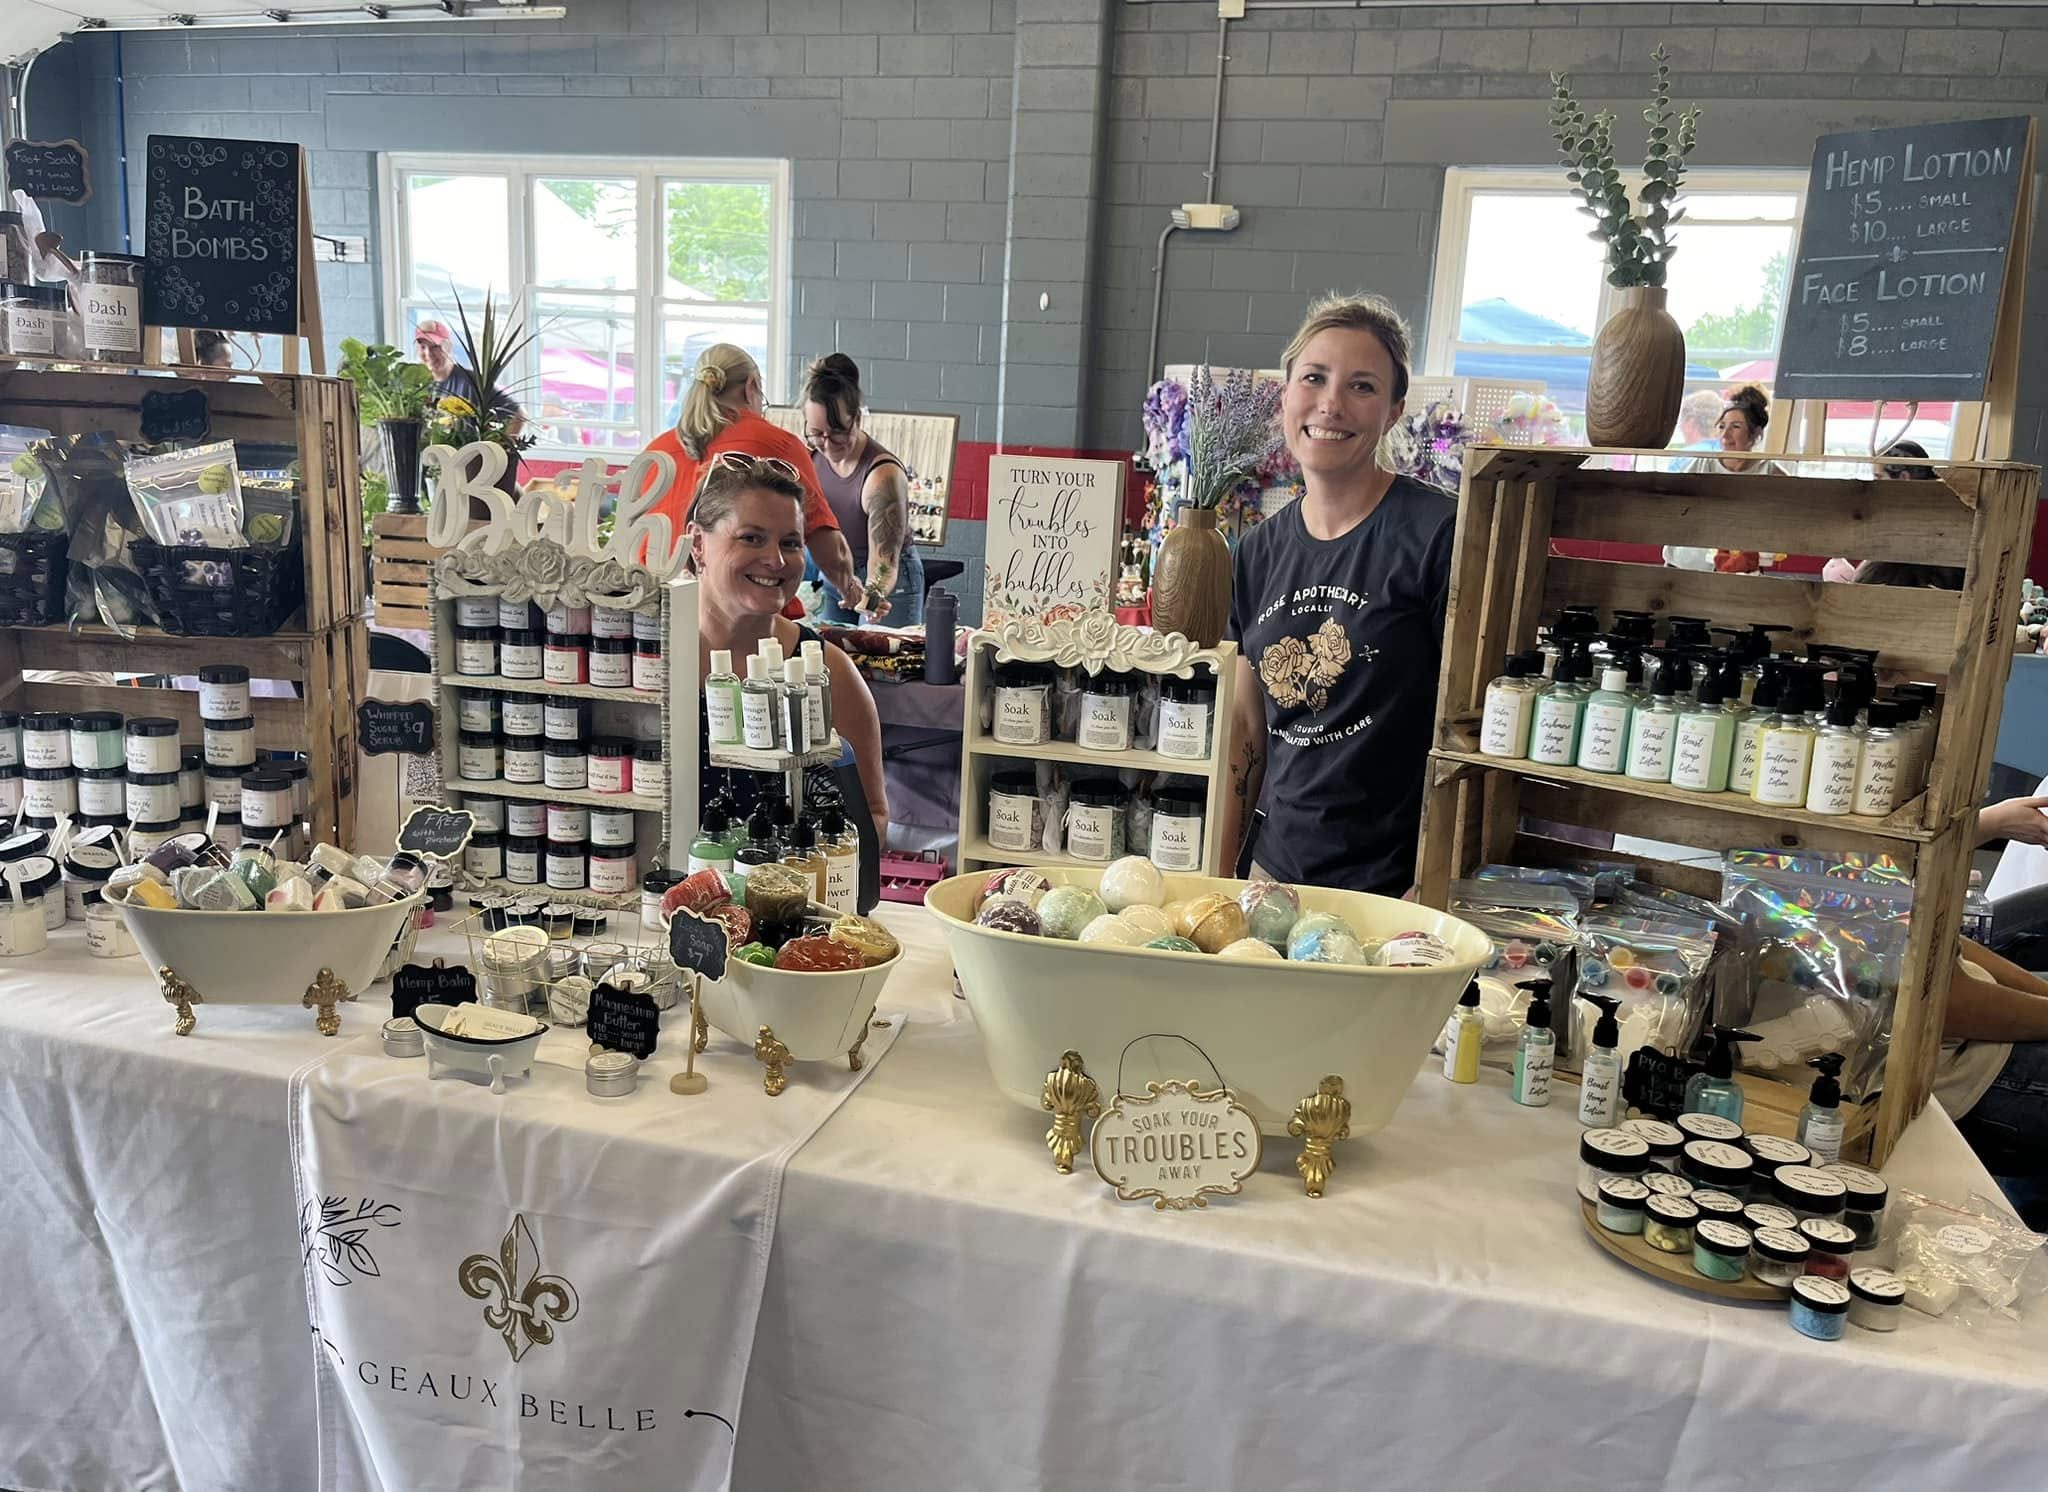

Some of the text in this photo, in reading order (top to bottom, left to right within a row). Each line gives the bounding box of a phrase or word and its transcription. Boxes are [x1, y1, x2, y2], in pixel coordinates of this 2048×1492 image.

[1825, 143, 2012, 190] HEMP LOTION
[184, 187, 254, 222] BATH
[1919, 192, 1972, 209] SMALL
[1916, 218, 1972, 239] LARGE
[172, 228, 268, 262] BOMBS
[1802, 270, 1985, 304] FACE LOTION
[1901, 316, 1944, 330] SMALL
[1900, 337, 1948, 352] LARGE
[1010, 468, 1096, 488] TURN YOUR
[423, 440, 694, 581] Bath
[998, 485, 1097, 538] troubles
[1032, 534, 1068, 550] INTO
[1005, 549, 1092, 599] bubbles
[1258, 594, 1286, 624] ROSE
[1004, 702, 1030, 715] Soak
[1092, 710, 1117, 723] Soak
[1167, 716, 1194, 730] Soak
[1313, 730, 1344, 745] WITH
[1345, 715, 1374, 735] CARE
[1640, 756, 1662, 767] Lotion
[1768, 777, 1789, 787] Lotion
[425, 813, 466, 830] FREE
[996, 810, 1020, 823] Soak
[1075, 819, 1100, 833] Soak
[1162, 830, 1187, 843] Soak
[400, 974, 471, 993] Hemp Balm
[595, 993, 655, 1019] Magnesium
[1586, 1092, 1607, 1105] Hemp
[1584, 1105, 1606, 1116] Lotion
[1132, 1111, 1218, 1134] SOAK YOUR
[1105, 1131, 1247, 1165] TROUBLES
[1158, 1165, 1200, 1180] AWAY
[357, 1360, 657, 1432] GEAUX BELLE
